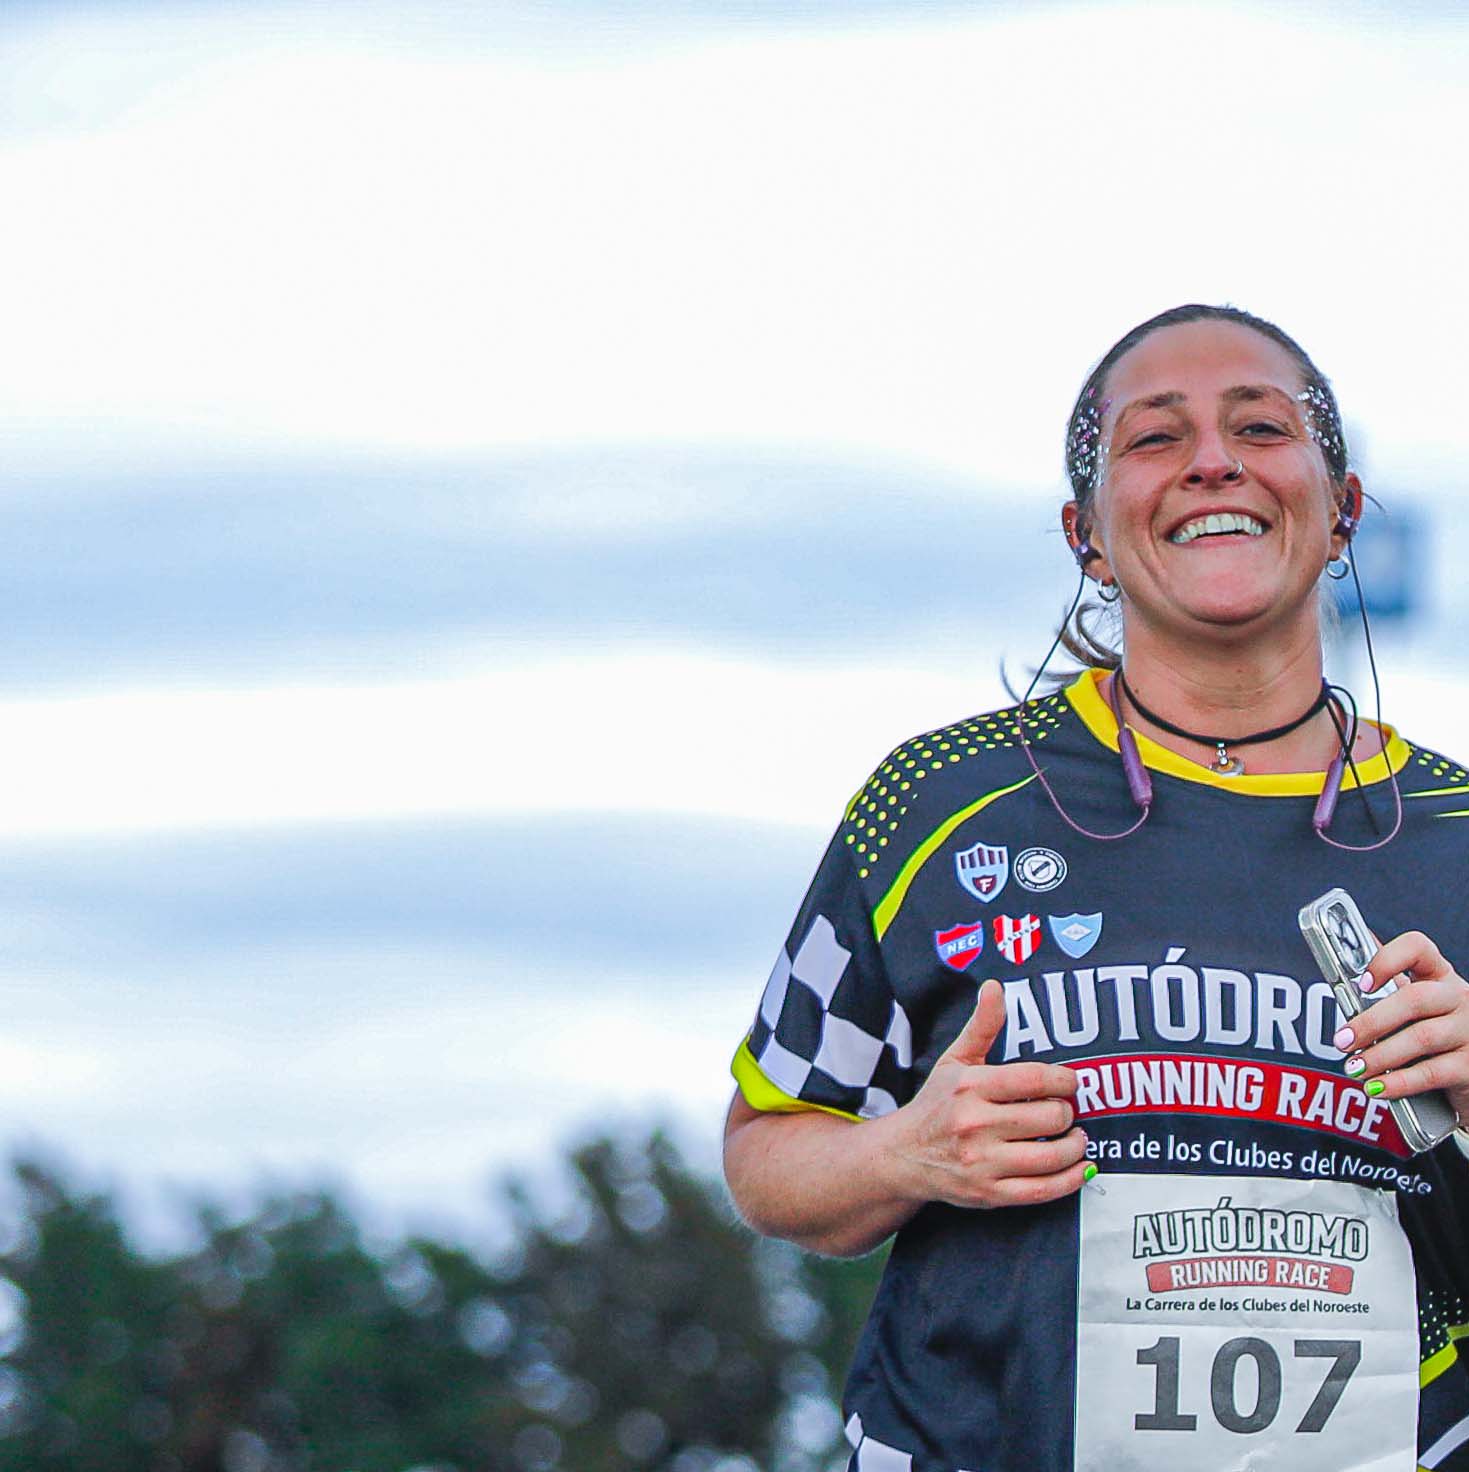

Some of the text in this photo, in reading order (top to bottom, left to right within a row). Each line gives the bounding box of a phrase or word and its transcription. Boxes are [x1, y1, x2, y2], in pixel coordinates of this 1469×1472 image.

[946, 934, 978, 955] NEC
[1003, 946, 1398, 1062] AUTÓDRO
[1076, 1060, 1389, 1142] RUNNING RACE
[1130, 1133, 1161, 1160] de
[1167, 1134, 1202, 1163] los
[1209, 1139, 1293, 1172] Clubes
[1300, 1151, 1336, 1176] del
[1341, 1154, 1432, 1195] Noroete
[1132, 1196, 1369, 1262] AUTÓDROMO
[1126, 1297, 1370, 1314] La Carrera de los Clubes del Noroeste
[1170, 1259, 1332, 1290] RUNNING RACE
[1134, 1335, 1363, 1434] 107
